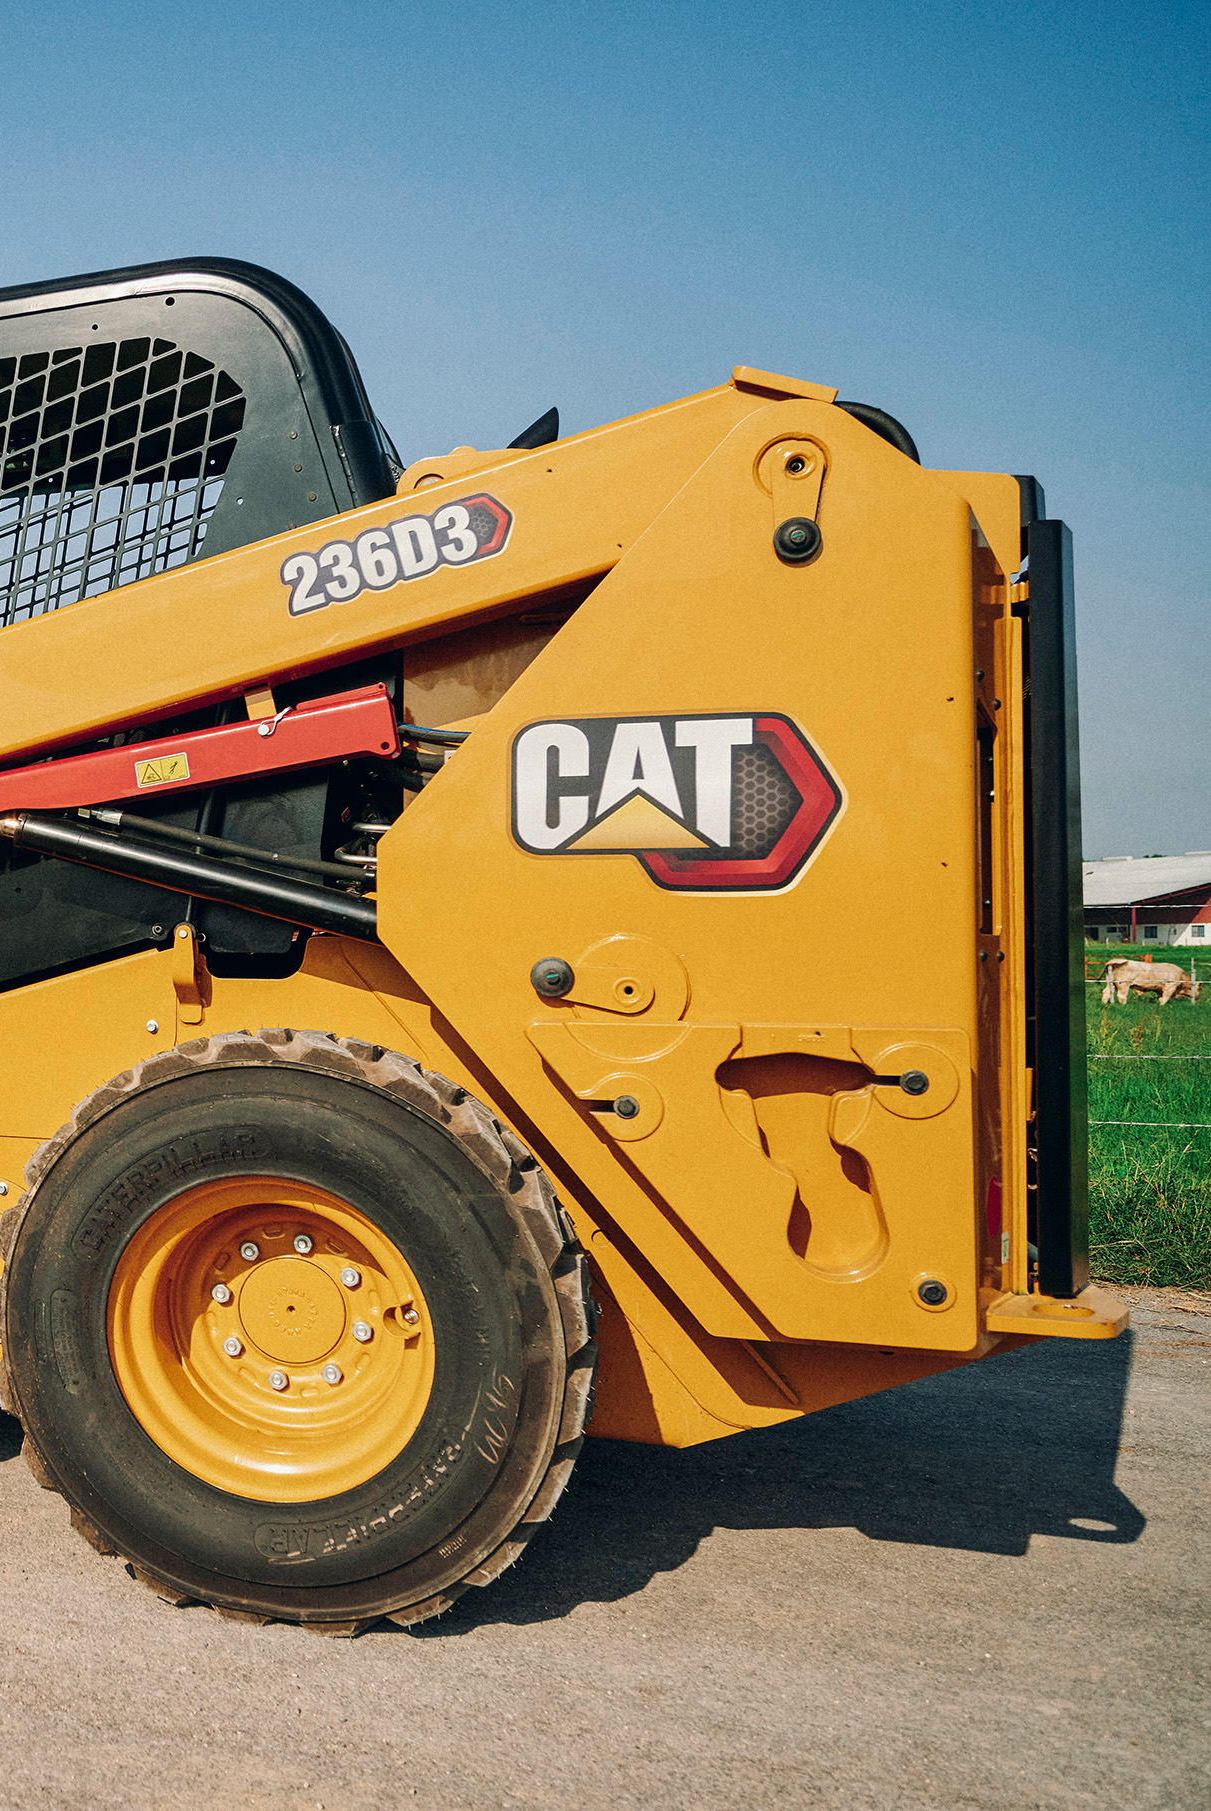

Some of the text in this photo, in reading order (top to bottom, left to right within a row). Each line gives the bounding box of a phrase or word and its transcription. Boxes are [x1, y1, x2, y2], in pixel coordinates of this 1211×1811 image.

[283, 505, 478, 612] 236D3
[516, 718, 753, 850] CAT
[78, 1130, 268, 1253] CATERPILLAR
